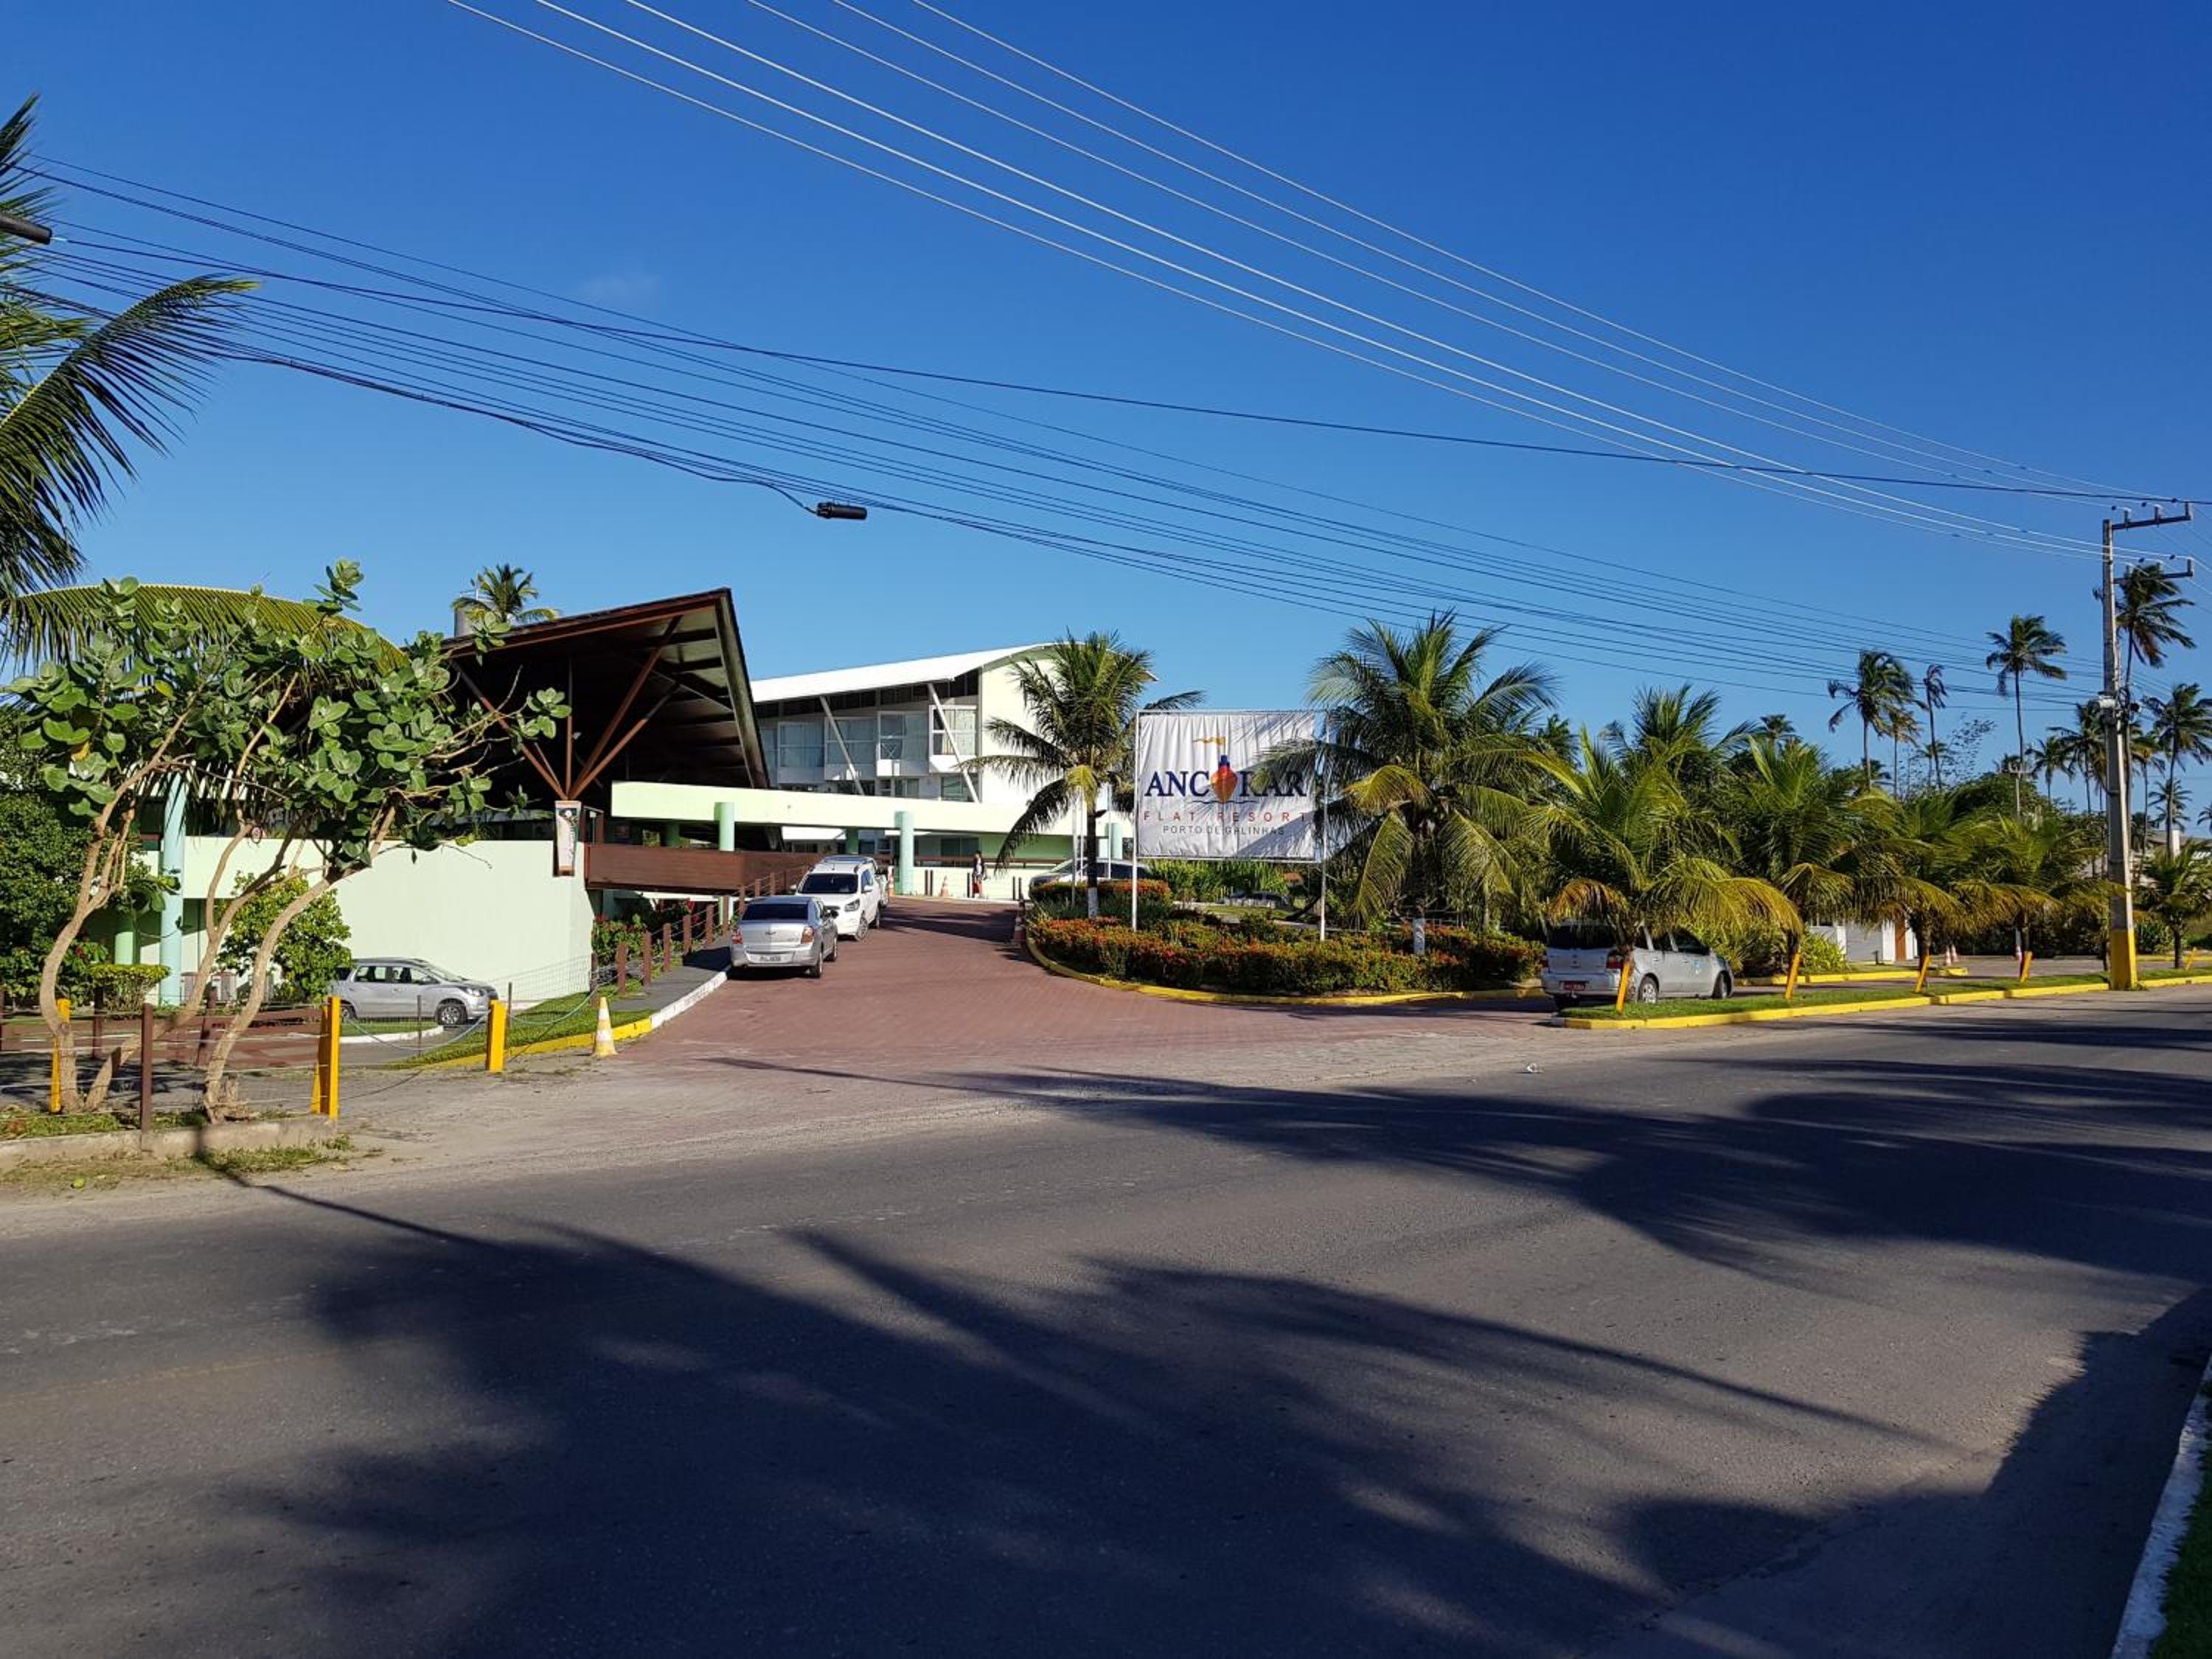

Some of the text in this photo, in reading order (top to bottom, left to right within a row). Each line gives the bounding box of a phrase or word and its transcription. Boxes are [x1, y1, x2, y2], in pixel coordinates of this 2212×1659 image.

[1144, 812, 1307, 822] FLAT RESORT
[1163, 825, 1203, 835] PORTO
